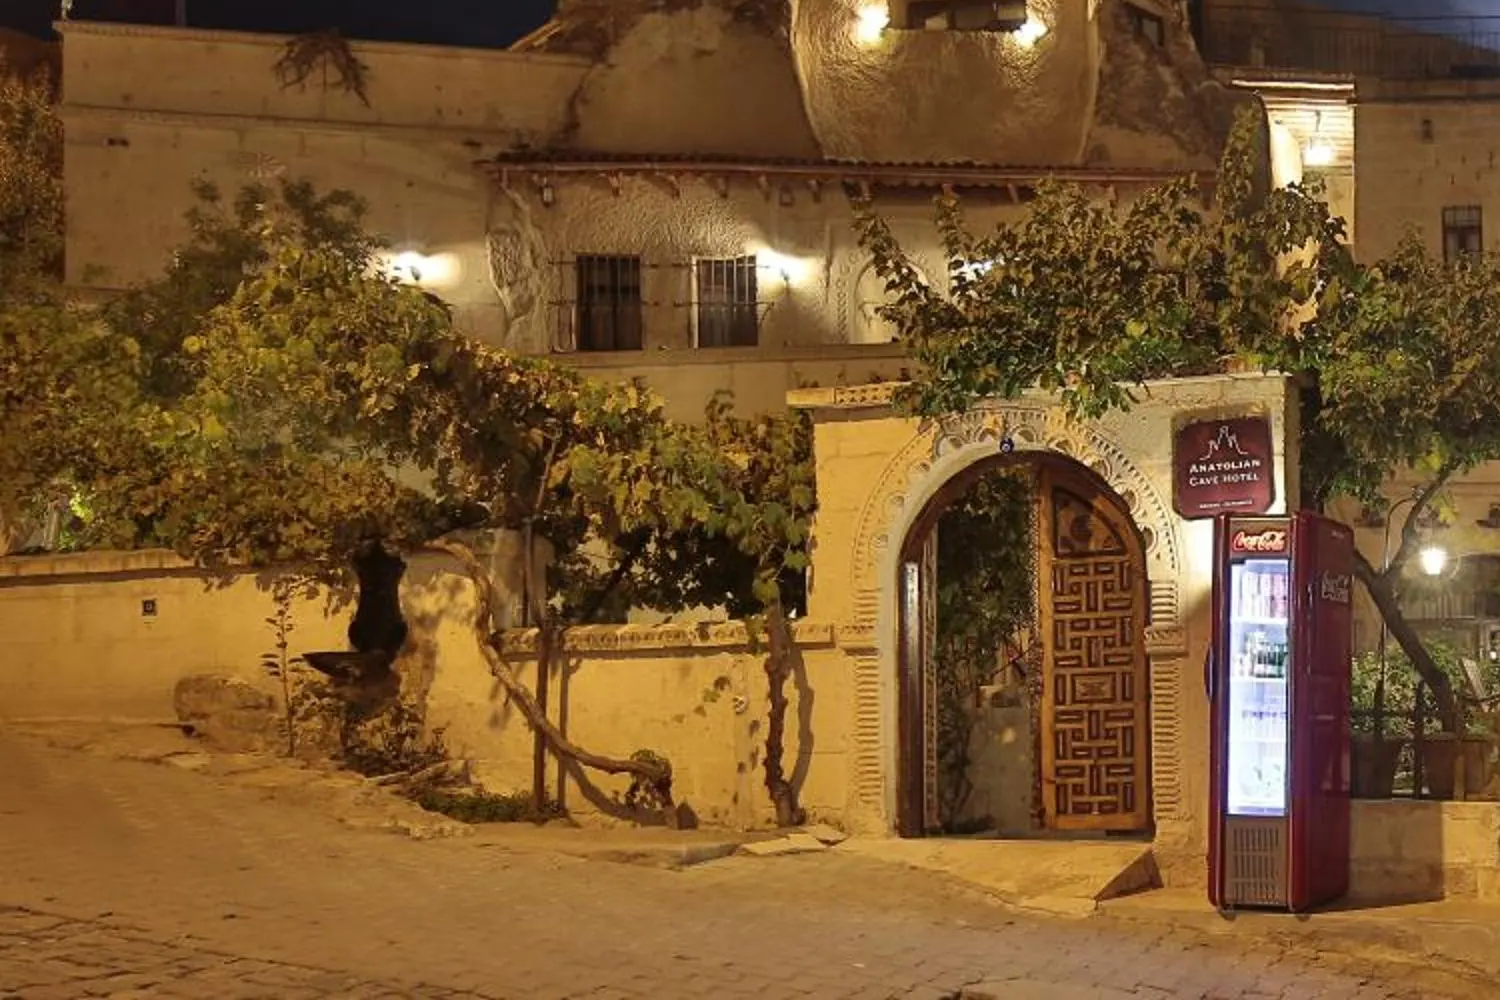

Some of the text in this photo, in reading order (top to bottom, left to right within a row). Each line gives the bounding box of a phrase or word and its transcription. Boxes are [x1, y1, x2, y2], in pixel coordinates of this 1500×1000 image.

[1189, 460, 1261, 474] ANATOLIAN
[1189, 472, 1260, 487] CAVE HOTEL
